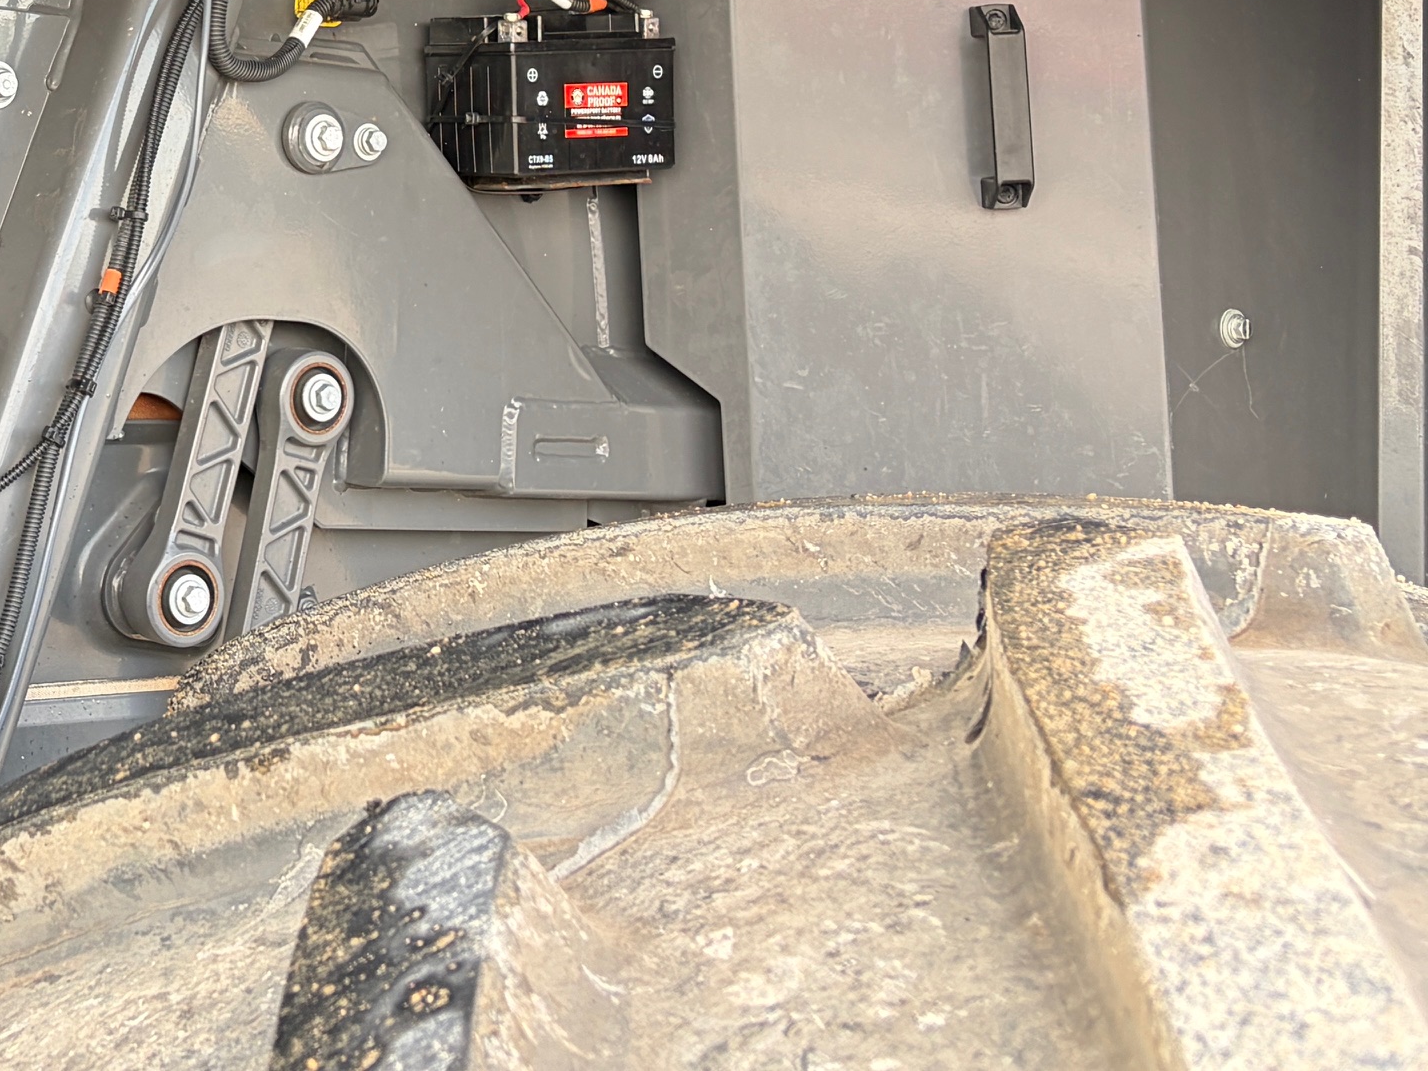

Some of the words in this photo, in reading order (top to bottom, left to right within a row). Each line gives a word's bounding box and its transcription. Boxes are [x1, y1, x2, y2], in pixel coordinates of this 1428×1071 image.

[586, 85, 622, 96] CANADA
[587, 96, 616, 107] PROOF
[632, 154, 647, 165] 12V
